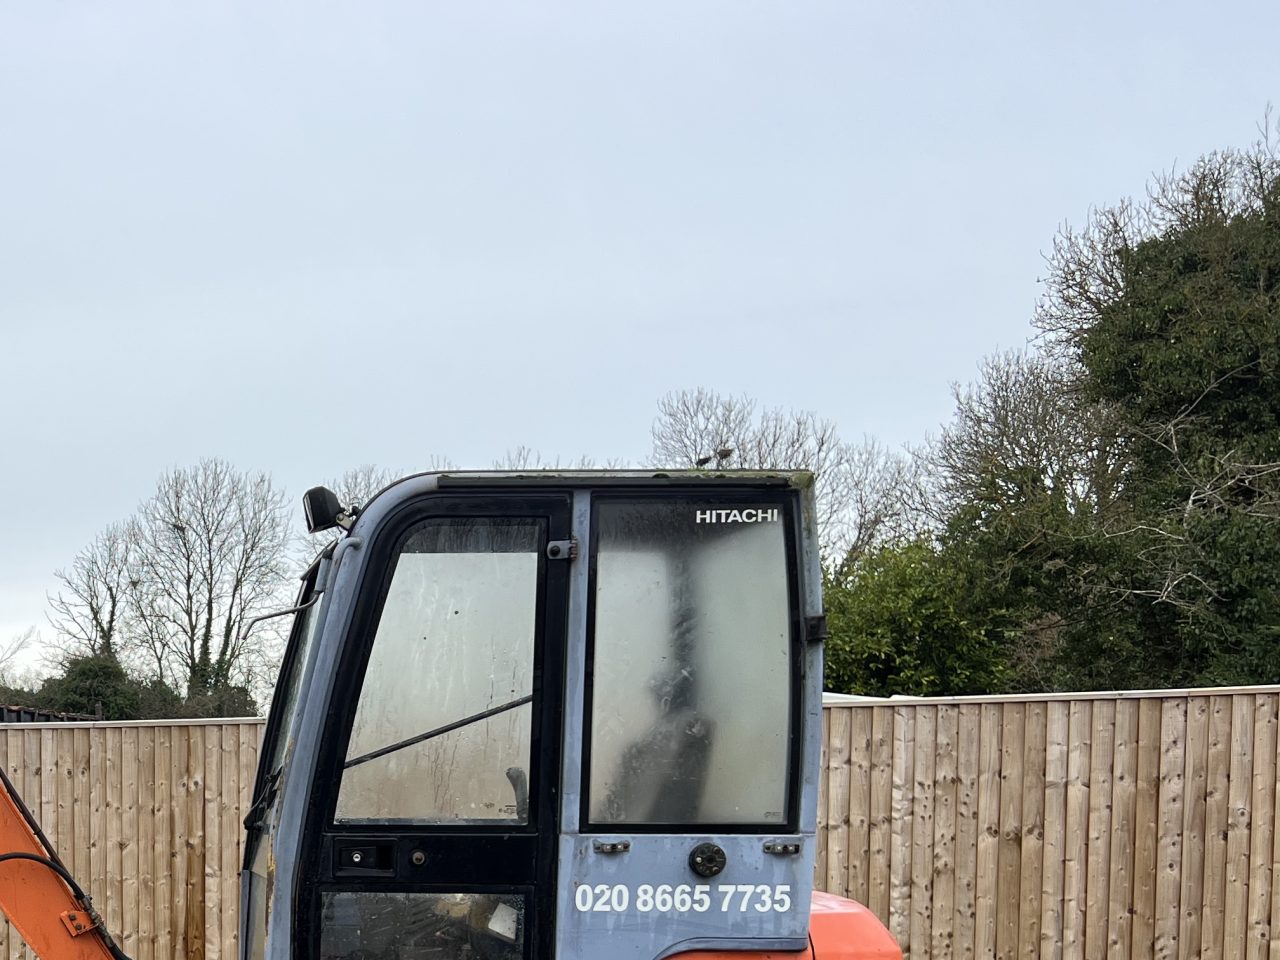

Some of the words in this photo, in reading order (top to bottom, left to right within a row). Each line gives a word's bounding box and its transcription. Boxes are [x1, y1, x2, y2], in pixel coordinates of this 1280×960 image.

[696, 509, 778, 523] HITACHI
[575, 884, 629, 912] 020
[636, 884, 710, 912] 8665
[718, 884, 791, 912] 7735
